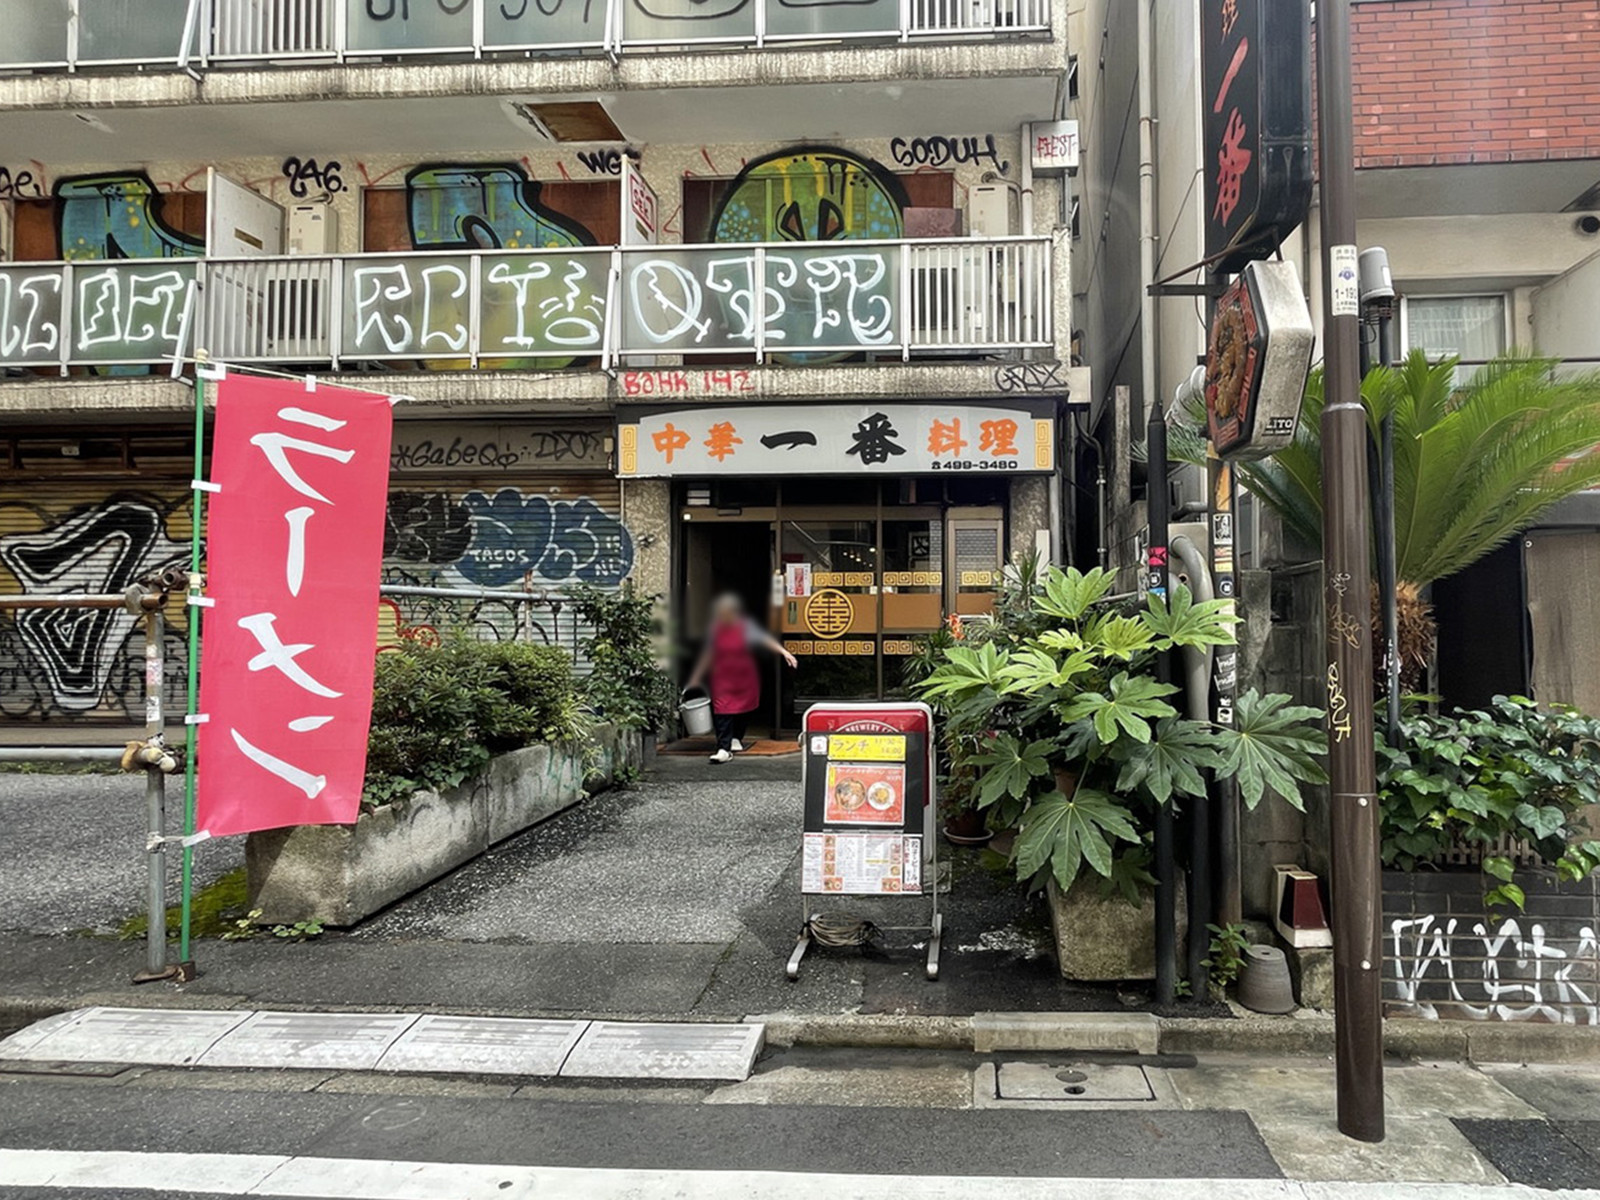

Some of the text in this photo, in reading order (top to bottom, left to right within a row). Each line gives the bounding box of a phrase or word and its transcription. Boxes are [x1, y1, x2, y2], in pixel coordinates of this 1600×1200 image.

[230, 407, 356, 799] ラーメン
[468, 549, 529, 563] TACOS
